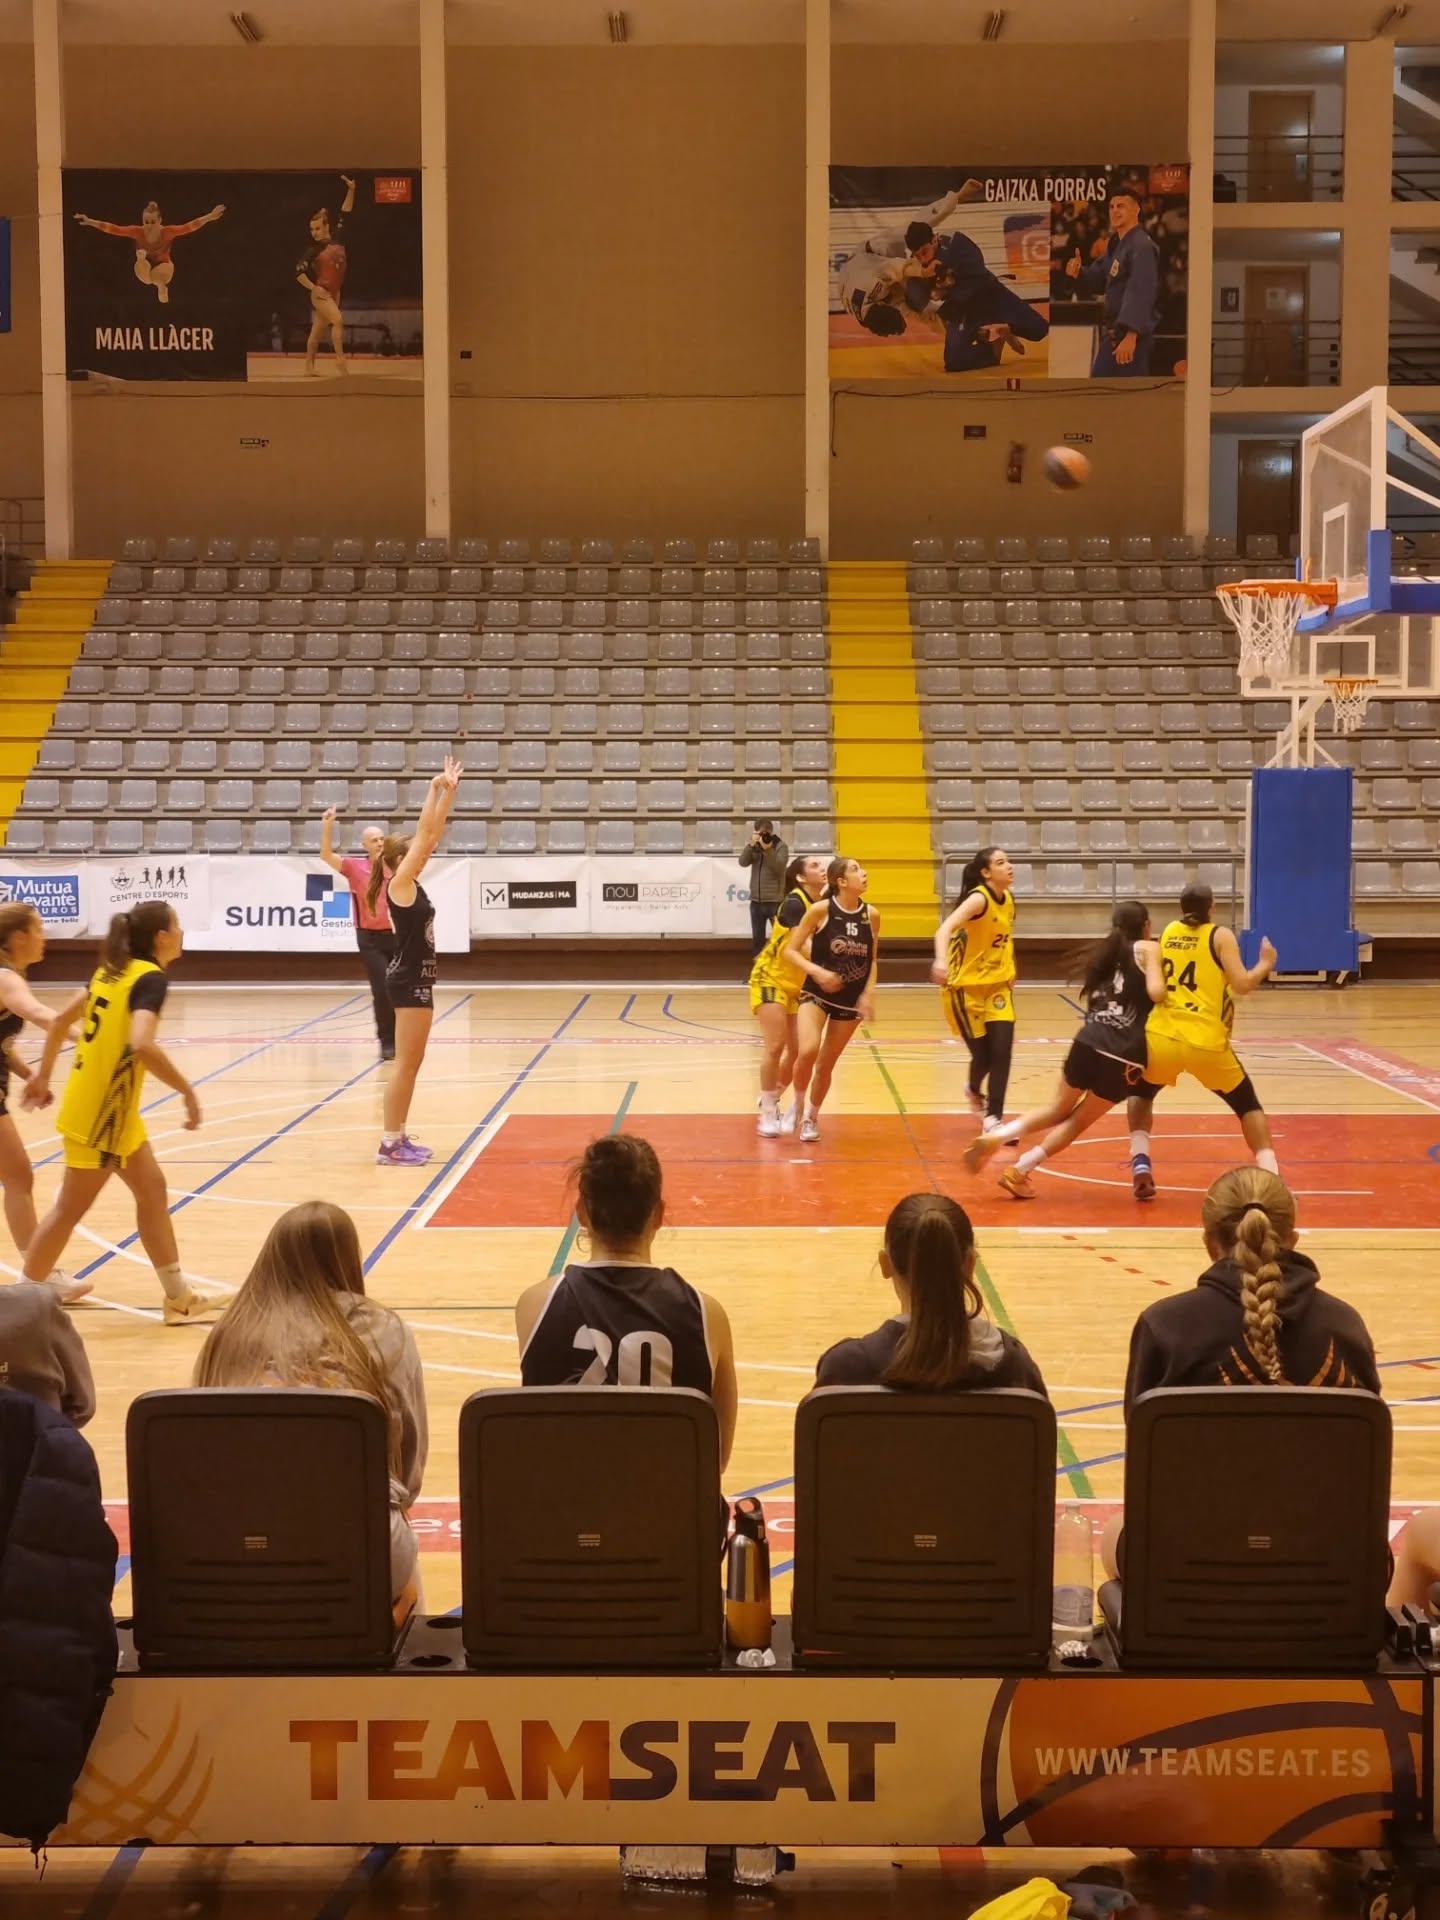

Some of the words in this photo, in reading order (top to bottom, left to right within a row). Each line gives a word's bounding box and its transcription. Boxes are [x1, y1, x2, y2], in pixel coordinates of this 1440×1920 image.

[985, 178, 1039, 202] GAIZKA
[1044, 178, 1107, 201] PORRAS
[95, 327, 144, 350] MAIA
[149, 323, 214, 351] LLÀCER
[15, 880, 72, 895] Mutua
[110, 891, 142, 903] CENTRE
[145, 891, 189, 900] D'ESPORTS
[511, 891, 554, 899] MUDANZAS
[642, 887, 689, 897] PAPER
[40, 906, 77, 914] UROS
[225, 905, 318, 927] suma
[321, 919, 355, 928] Gestió
[845, 922, 859, 936] 15
[1162, 957, 1198, 992] 24
[84, 996, 110, 1043] 5
[573, 1323, 673, 1387] 20
[289, 1719, 896, 1802] TEAMSEAT
[1034, 1747, 1371, 1777] WWW.TEAMSEAT.ES
